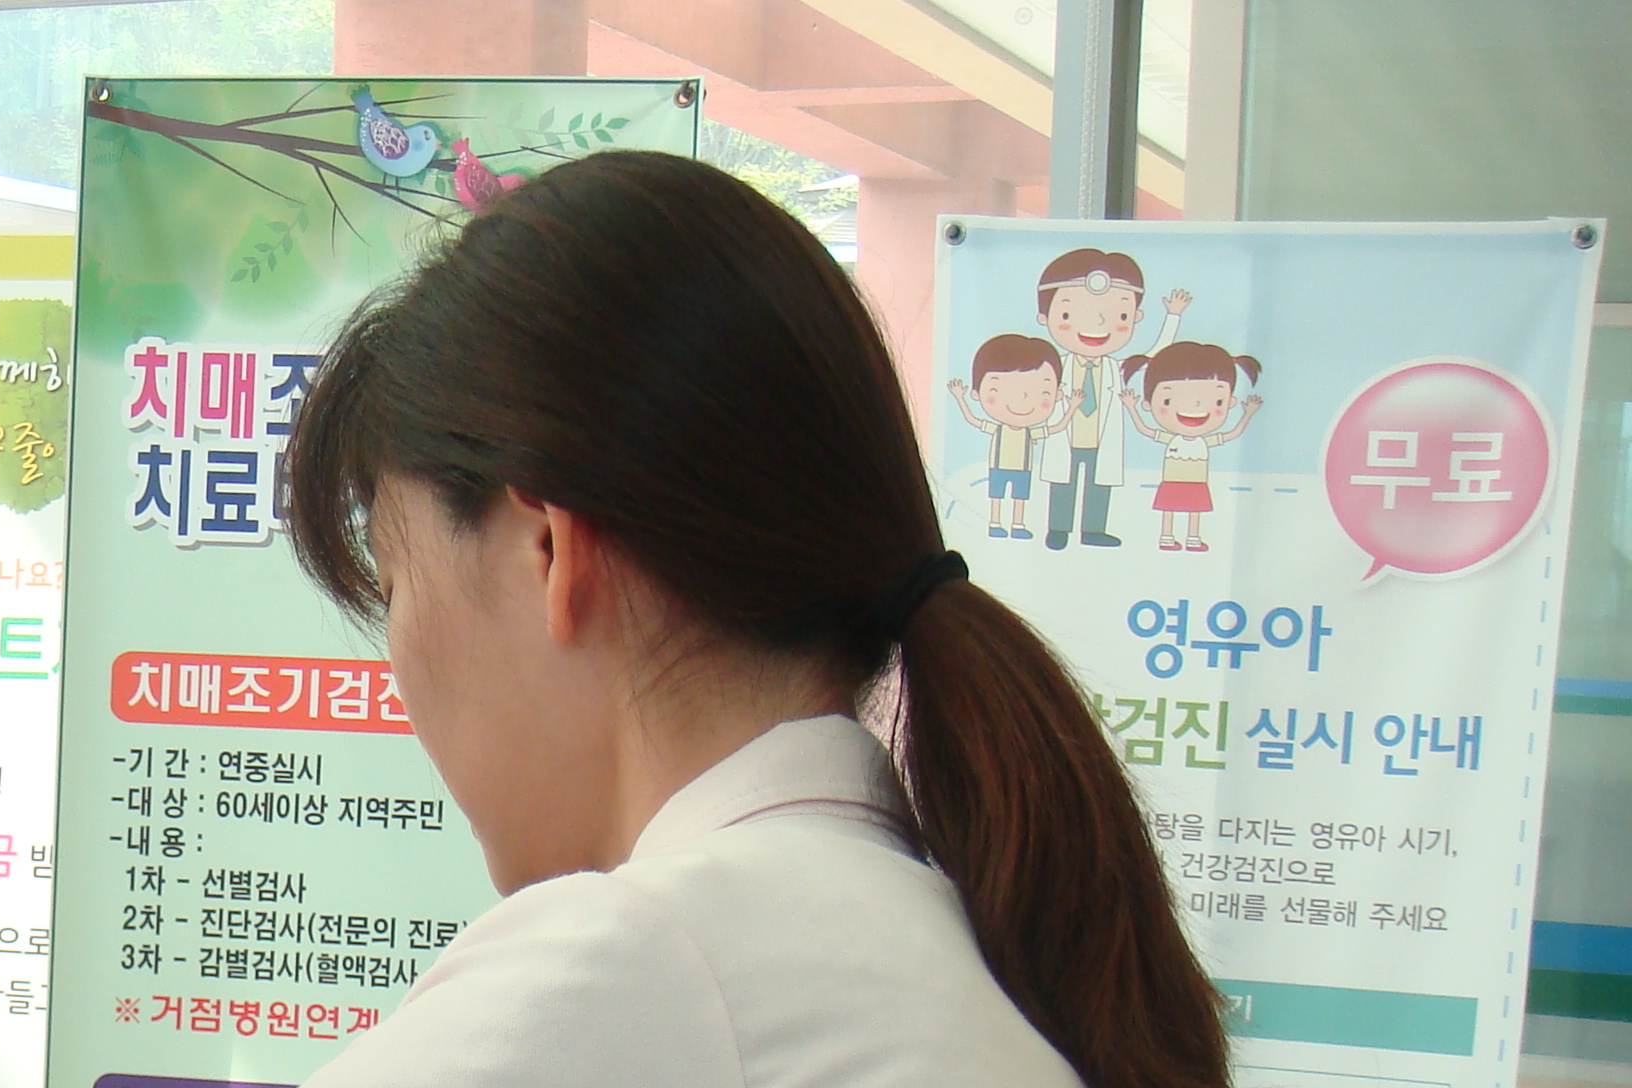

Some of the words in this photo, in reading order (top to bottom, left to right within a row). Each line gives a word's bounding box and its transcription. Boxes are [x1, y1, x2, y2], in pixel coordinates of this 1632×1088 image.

[134, 444, 292, 537] 치료
[1349, 429, 1513, 510] 무료
[1127, 598, 1333, 679] 영유아
[1095, 693, 1230, 770] 검진
[1244, 707, 1355, 771] 실시
[1373, 712, 1483, 777] 안내
[165, 748, 189, 779] 간
[218, 749, 323, 786] 연중실시
[164, 787, 188, 820] 상
[215, 791, 328, 827] 60세이상
[338, 796, 445, 832] 지역주민
[160, 827, 186, 859] 용
[1148, 812, 1205, 842] 탕을
[1217, 817, 1297, 848] 다지는
[1309, 820, 1386, 853] 영유아
[1397, 826, 1458, 858] 시기,
[125, 864, 165, 897] 1차
[201, 867, 307, 904] 선별검사
[1179, 852, 1336, 886] 건강검진으로
[122, 903, 164, 936] 2차
[200, 906, 397, 949] 진단검사(전문의
[407, 917, 469, 950] 진료
[1190, 890, 1267, 923] 미래를
[1280, 894, 1357, 928] 선물해
[1369, 902, 1448, 933] 주세요
[121, 943, 162, 975] 3차
[198, 946, 418, 989] 감별검사(혈액검사
